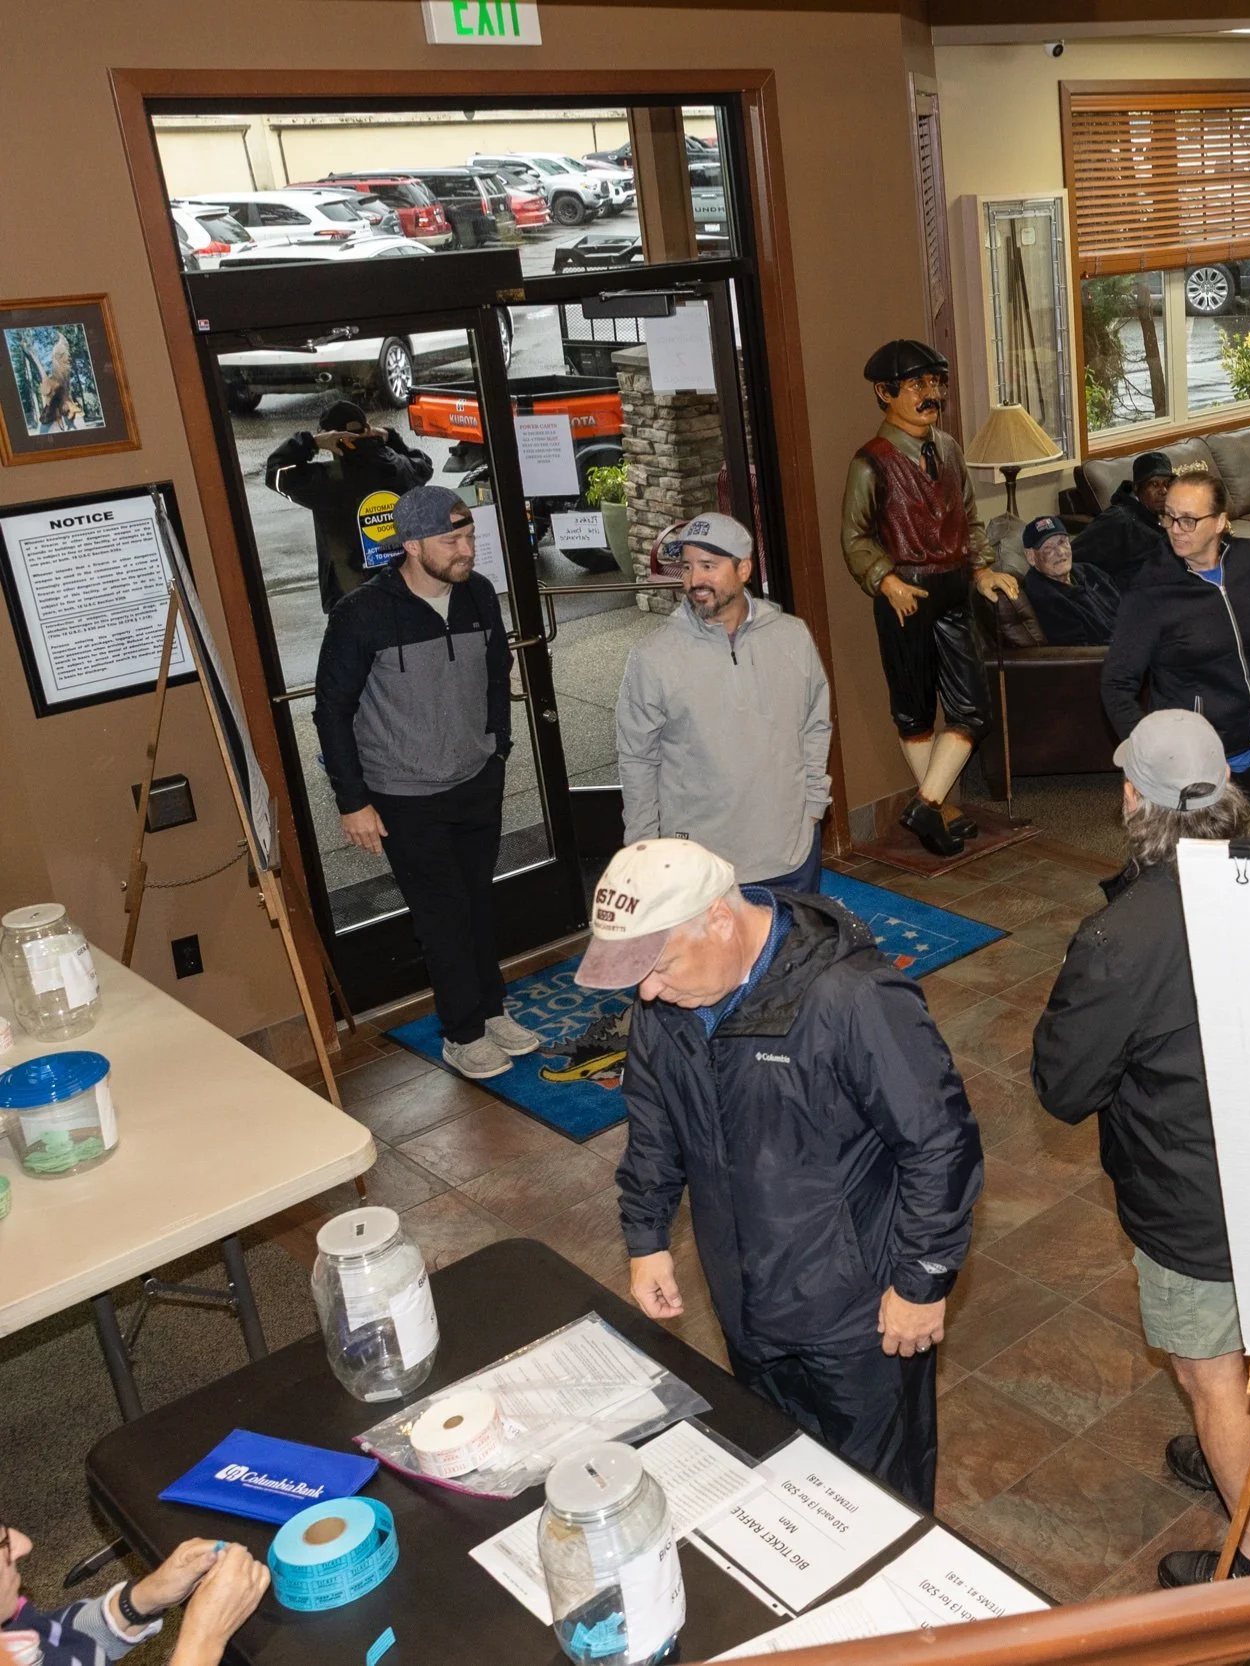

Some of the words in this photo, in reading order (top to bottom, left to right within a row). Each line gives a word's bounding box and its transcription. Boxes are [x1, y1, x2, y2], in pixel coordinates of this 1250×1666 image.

[49, 511, 115, 530] NOTICE
[762, 1052, 791, 1064] Columbia
[240, 1470, 297, 1492] Columbia
[292, 1481, 325, 1499] Bank
[781, 1480, 801, 1496] $20)
[805, 1472, 824, 1489] #18)
[798, 1493, 809, 1504] for
[825, 1487, 835, 1496] #1
[833, 1493, 860, 1514] (ITEMS
[730, 1506, 765, 1535] RAFFLE
[815, 1507, 833, 1523] each
[778, 1514, 800, 1534] Men
[832, 1519, 849, 1534] $10
[760, 1530, 790, 1557] TICKET
[789, 1554, 811, 1571] BIG
[918, 1578, 941, 1595] $20)
[945, 1571, 964, 1588] #18)
[939, 1588, 950, 1600] for
[979, 1594, 1006, 1617] (ITEMS
